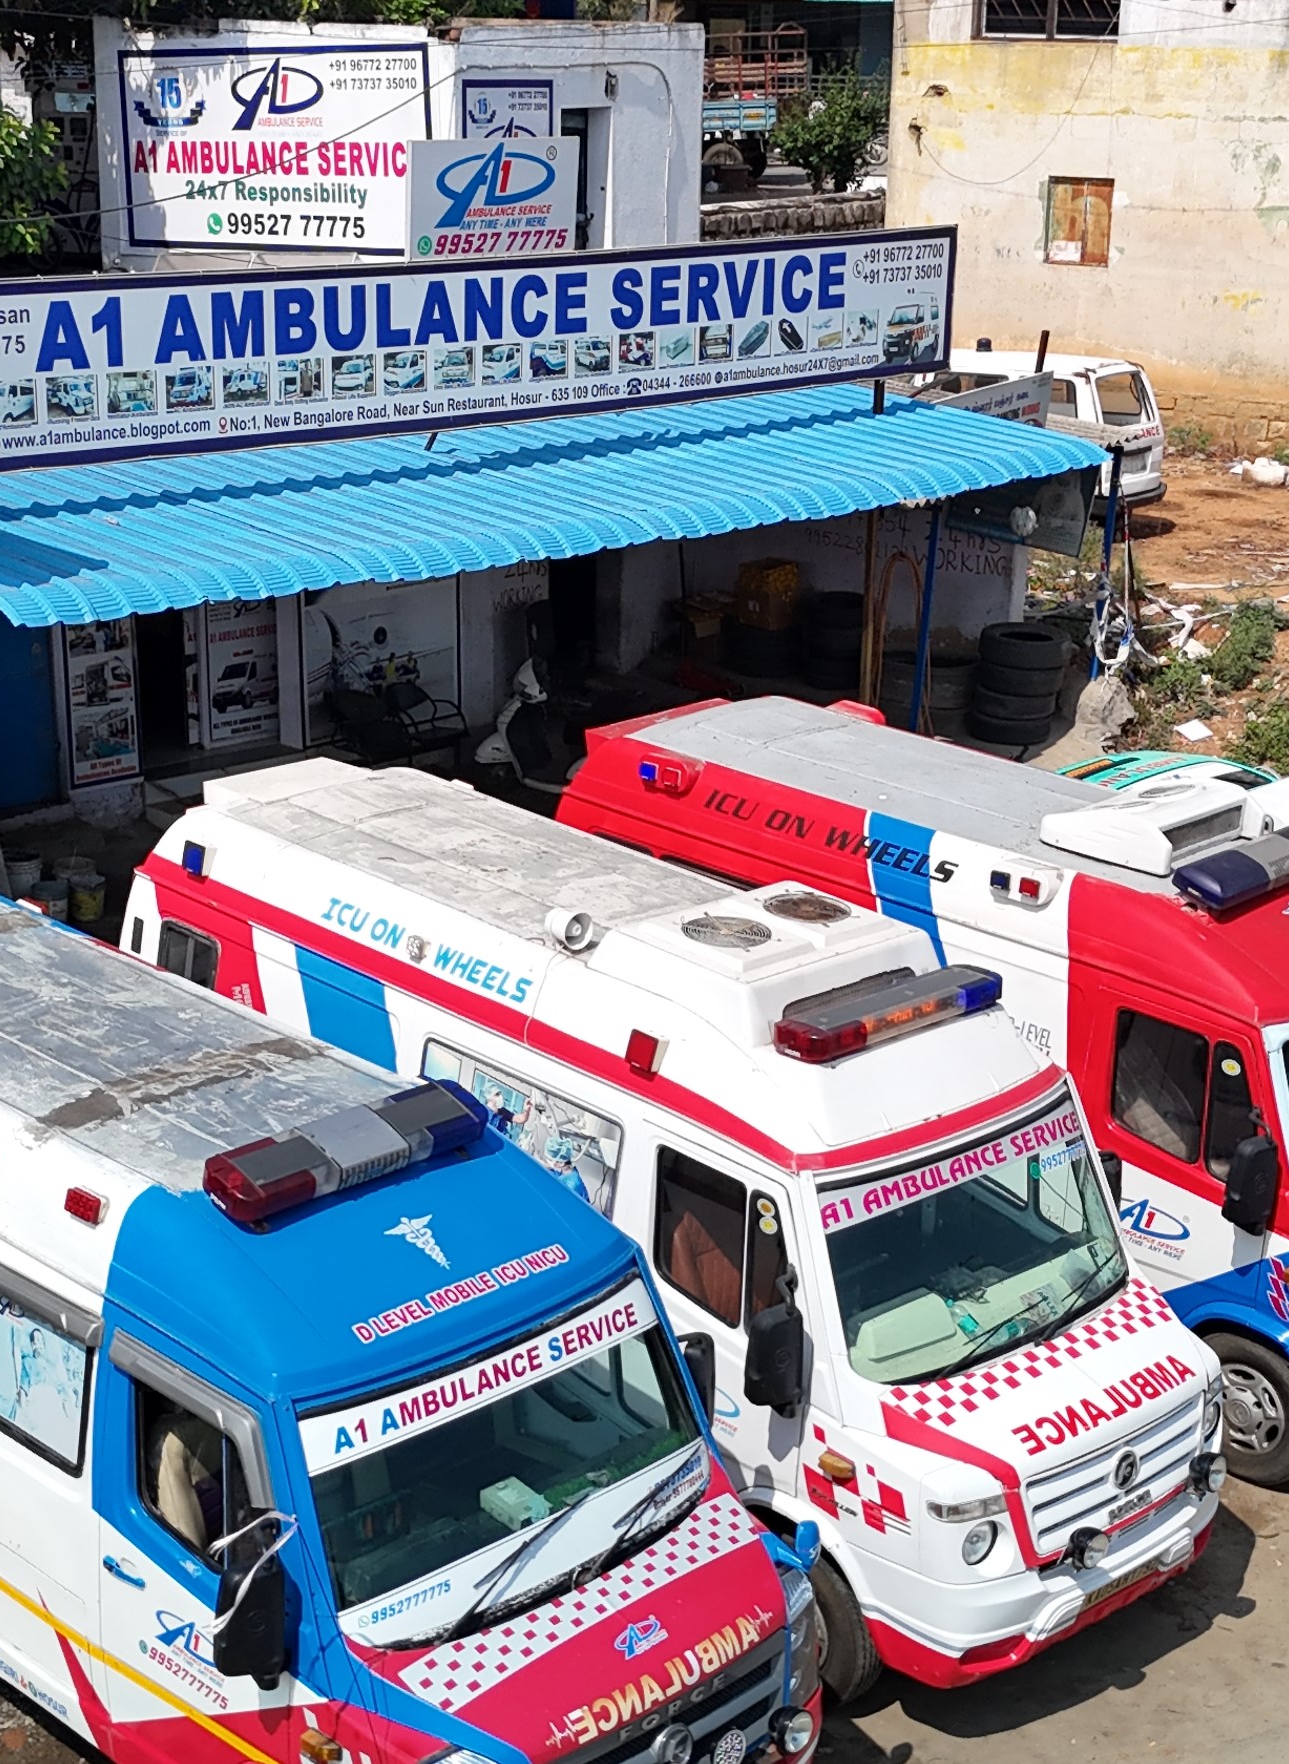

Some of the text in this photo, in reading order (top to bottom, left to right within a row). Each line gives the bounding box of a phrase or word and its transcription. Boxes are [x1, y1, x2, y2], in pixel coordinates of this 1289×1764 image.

[329, 57, 417, 72] +91 96772 27700
[156, 77, 181, 110] 15
[329, 76, 417, 91] +91 73737 35010
[258, 117, 324, 128] AMBULANCE SERVICE
[134, 141, 408, 178] A1 AMBULANCE SERVIC
[185, 180, 368, 209] 24x7 Responsibility
[466, 204, 553, 219] AMBULANCE SERVICE
[227, 213, 366, 239] 99527 77775
[460, 219, 477, 230] ANY
[479, 218, 500, 230] TIME
[504, 217, 521, 228] ANY
[434, 228, 568, 255] 99527 77775
[863, 243, 944, 264] +91 96772 27700
[863, 263, 943, 285] +91 73737 35010
[35, 251, 848, 373] A1 AMBULANCE SERVICE
[2, 418, 211, 450] www.a1ambulance.blogpot.com
[264, 410, 290, 429] New
[293, 407, 354, 427] Bangalore
[357, 403, 390, 421] Road,
[393, 400, 420, 417] Near
[422, 398, 444, 414] Sun
[447, 394, 508, 411] Restaurant,
[511, 391, 543, 405] Hosur
[551, 387, 569, 401] 635
[572, 386, 588, 399] 109
[591, 382, 620, 397] Office
[642, 378, 670, 392] 04344
[678, 372, 711, 388] 266600
[704, 789, 960, 883] ICU ON WHEELS
[321, 897, 534, 1004] ICU ON WHEELS
[820, 1110, 1081, 1230] A1 AMBULANCE SERVICE
[375, 1245, 569, 1336] LEVEL MOBILE ICU NICU
[334, 1302, 638, 1454] A1 AMBULANCE SERVICE
[371, 1579, 452, 1625] 9952777775
[148, 1646, 230, 1711] 9952777775
[620, 1672, 727, 1745] FORCE
